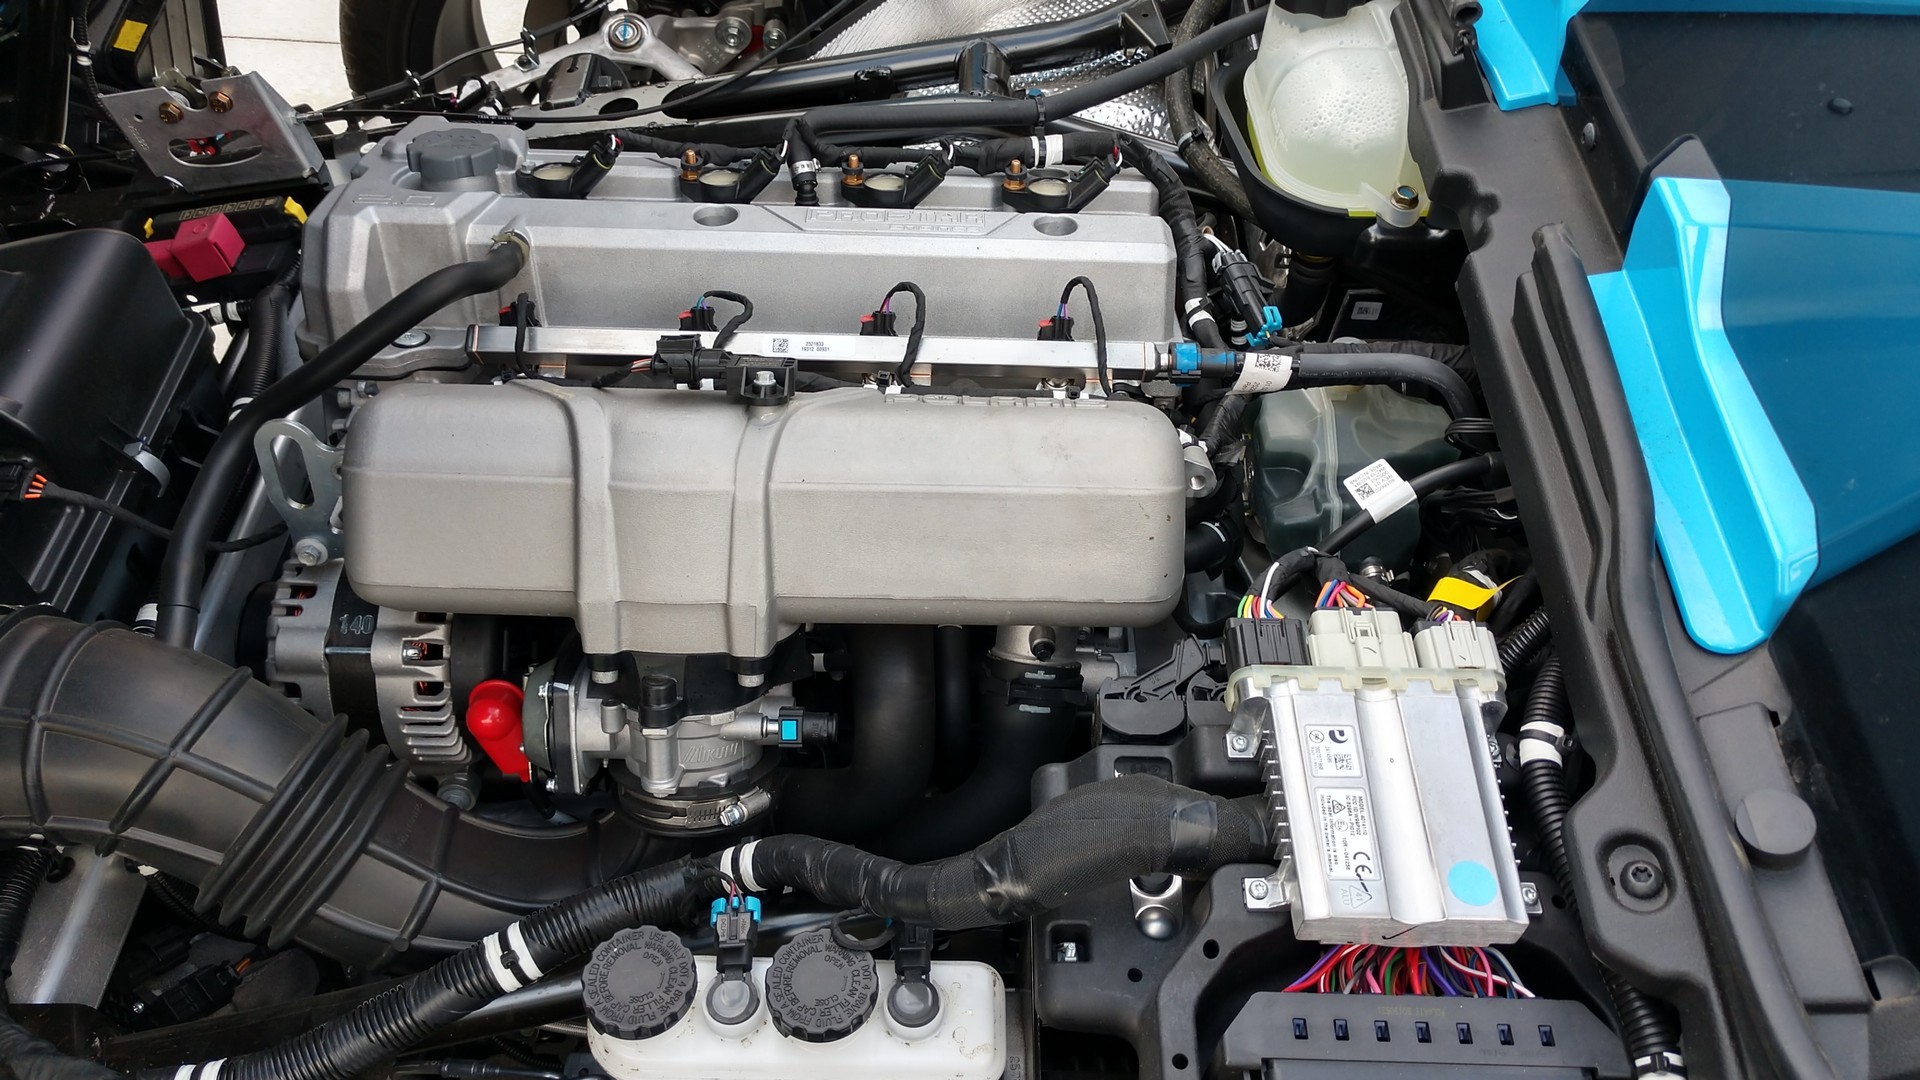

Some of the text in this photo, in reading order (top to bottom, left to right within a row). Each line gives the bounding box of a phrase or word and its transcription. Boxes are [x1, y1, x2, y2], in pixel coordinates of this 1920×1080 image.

[340, 614, 375, 634] 140
[649, 931, 667, 942] USE
[596, 931, 644, 962] CONTAINER
[667, 940, 686, 959] ONLY
[779, 935, 824, 964] CONTAINER
[642, 952, 663, 967] OPEN
[825, 955, 845, 970] OPEN
[599, 941, 677, 1014] WARNING CLEAN FILLER CAP BEFORE REMOVAL
[679, 962, 689, 978] DOT
[862, 964, 871, 981] DOT
[588, 963, 600, 999] SEALED
[773, 966, 785, 1002] SEALED
[783, 944, 860, 1017] WARNING CLEAN FILLER CAP BEFORE REMOVAL
[629, 992, 654, 1004] CLOSE
[660, 990, 683, 1016] BRAKE
[815, 995, 839, 1006] CLOSE
[843, 993, 868, 1018] BRAKE
[600, 1006, 625, 1023] FROM
[628, 1012, 656, 1024] FLUID
[786, 1009, 812, 1025] FROM
[816, 1015, 843, 1027] FLUID
